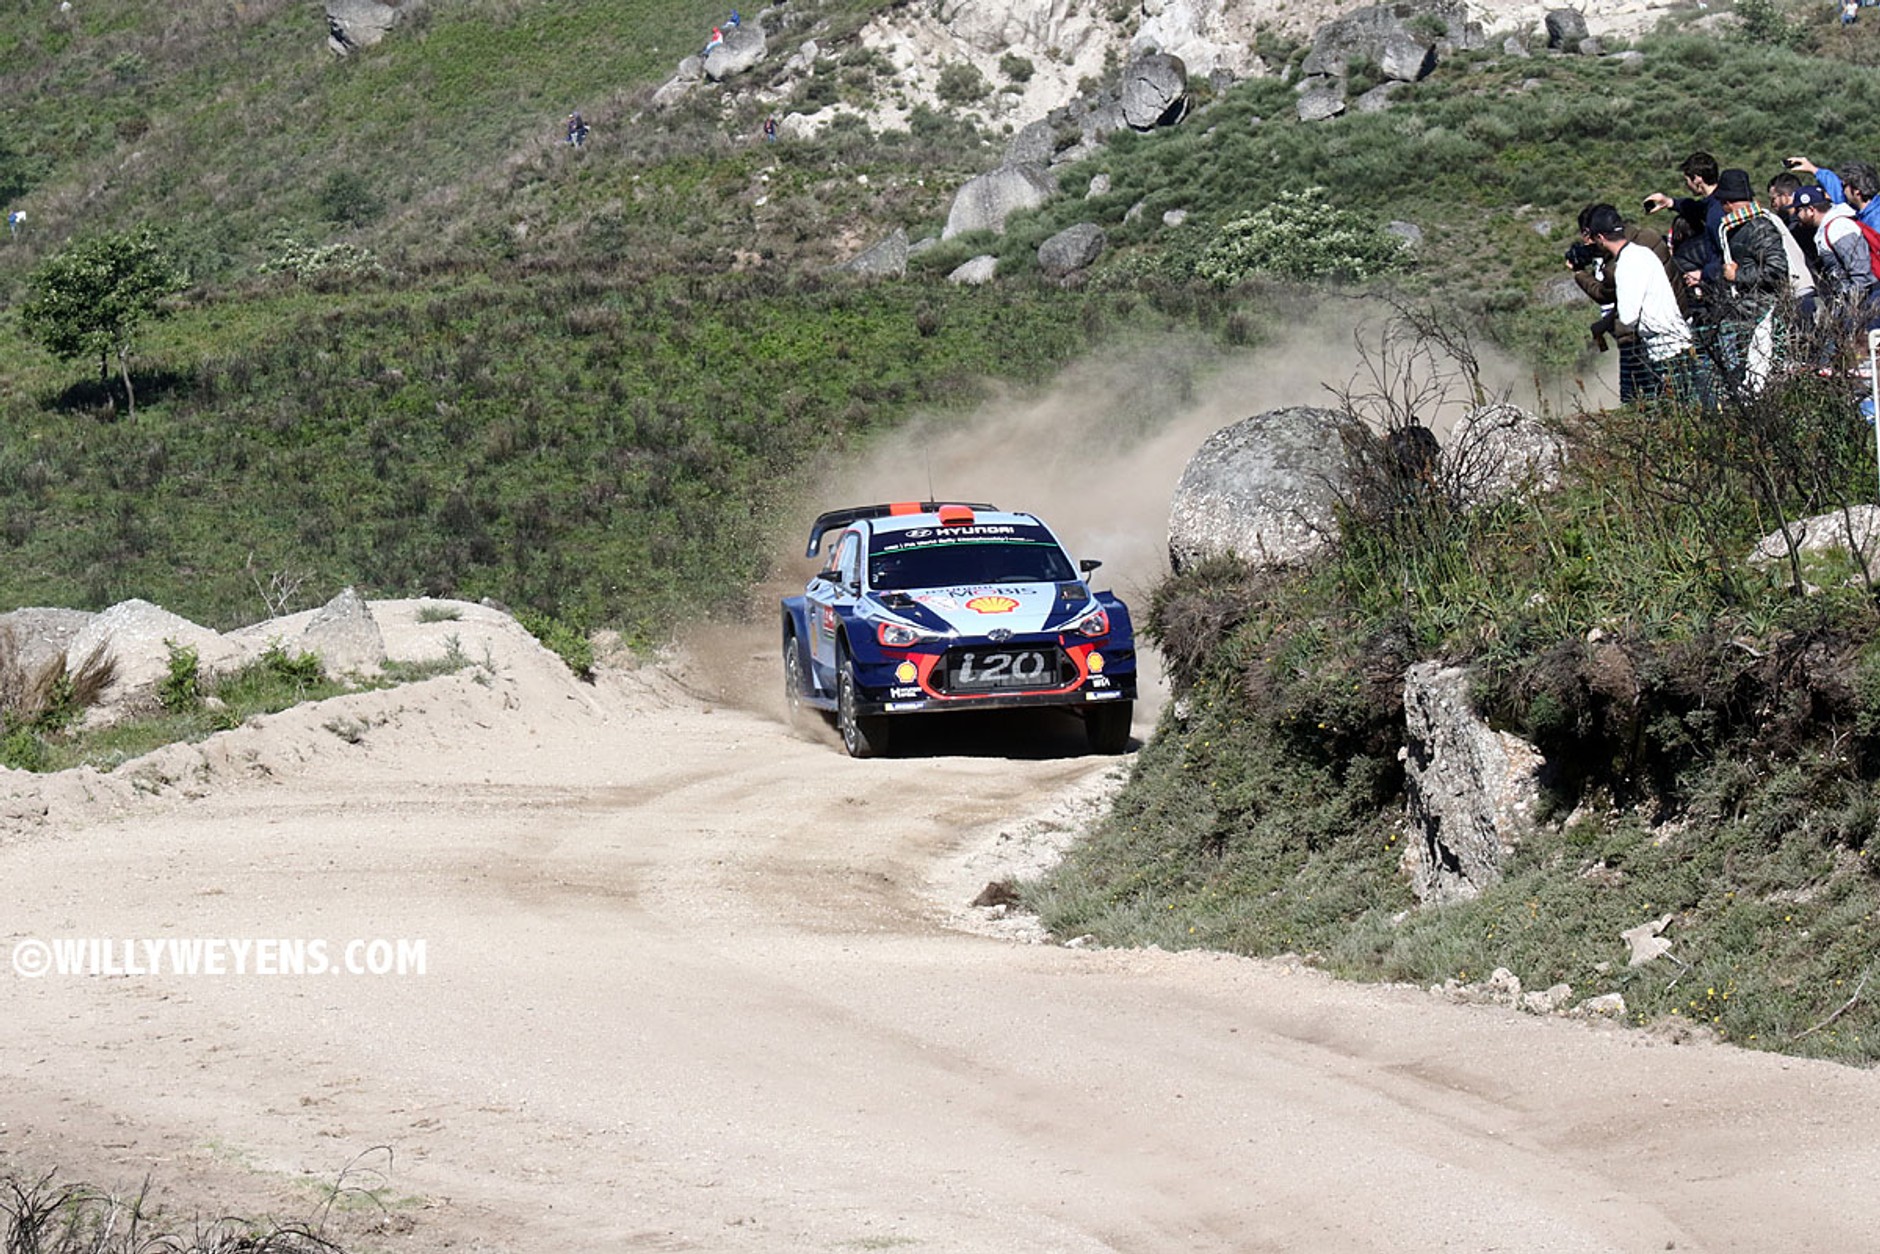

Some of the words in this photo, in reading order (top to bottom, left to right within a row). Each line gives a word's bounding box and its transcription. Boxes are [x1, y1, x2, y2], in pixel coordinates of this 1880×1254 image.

[936, 525, 1015, 536] HYUNDAI
[947, 586, 1037, 597] MOBIS
[958, 652, 1045, 683] i20
